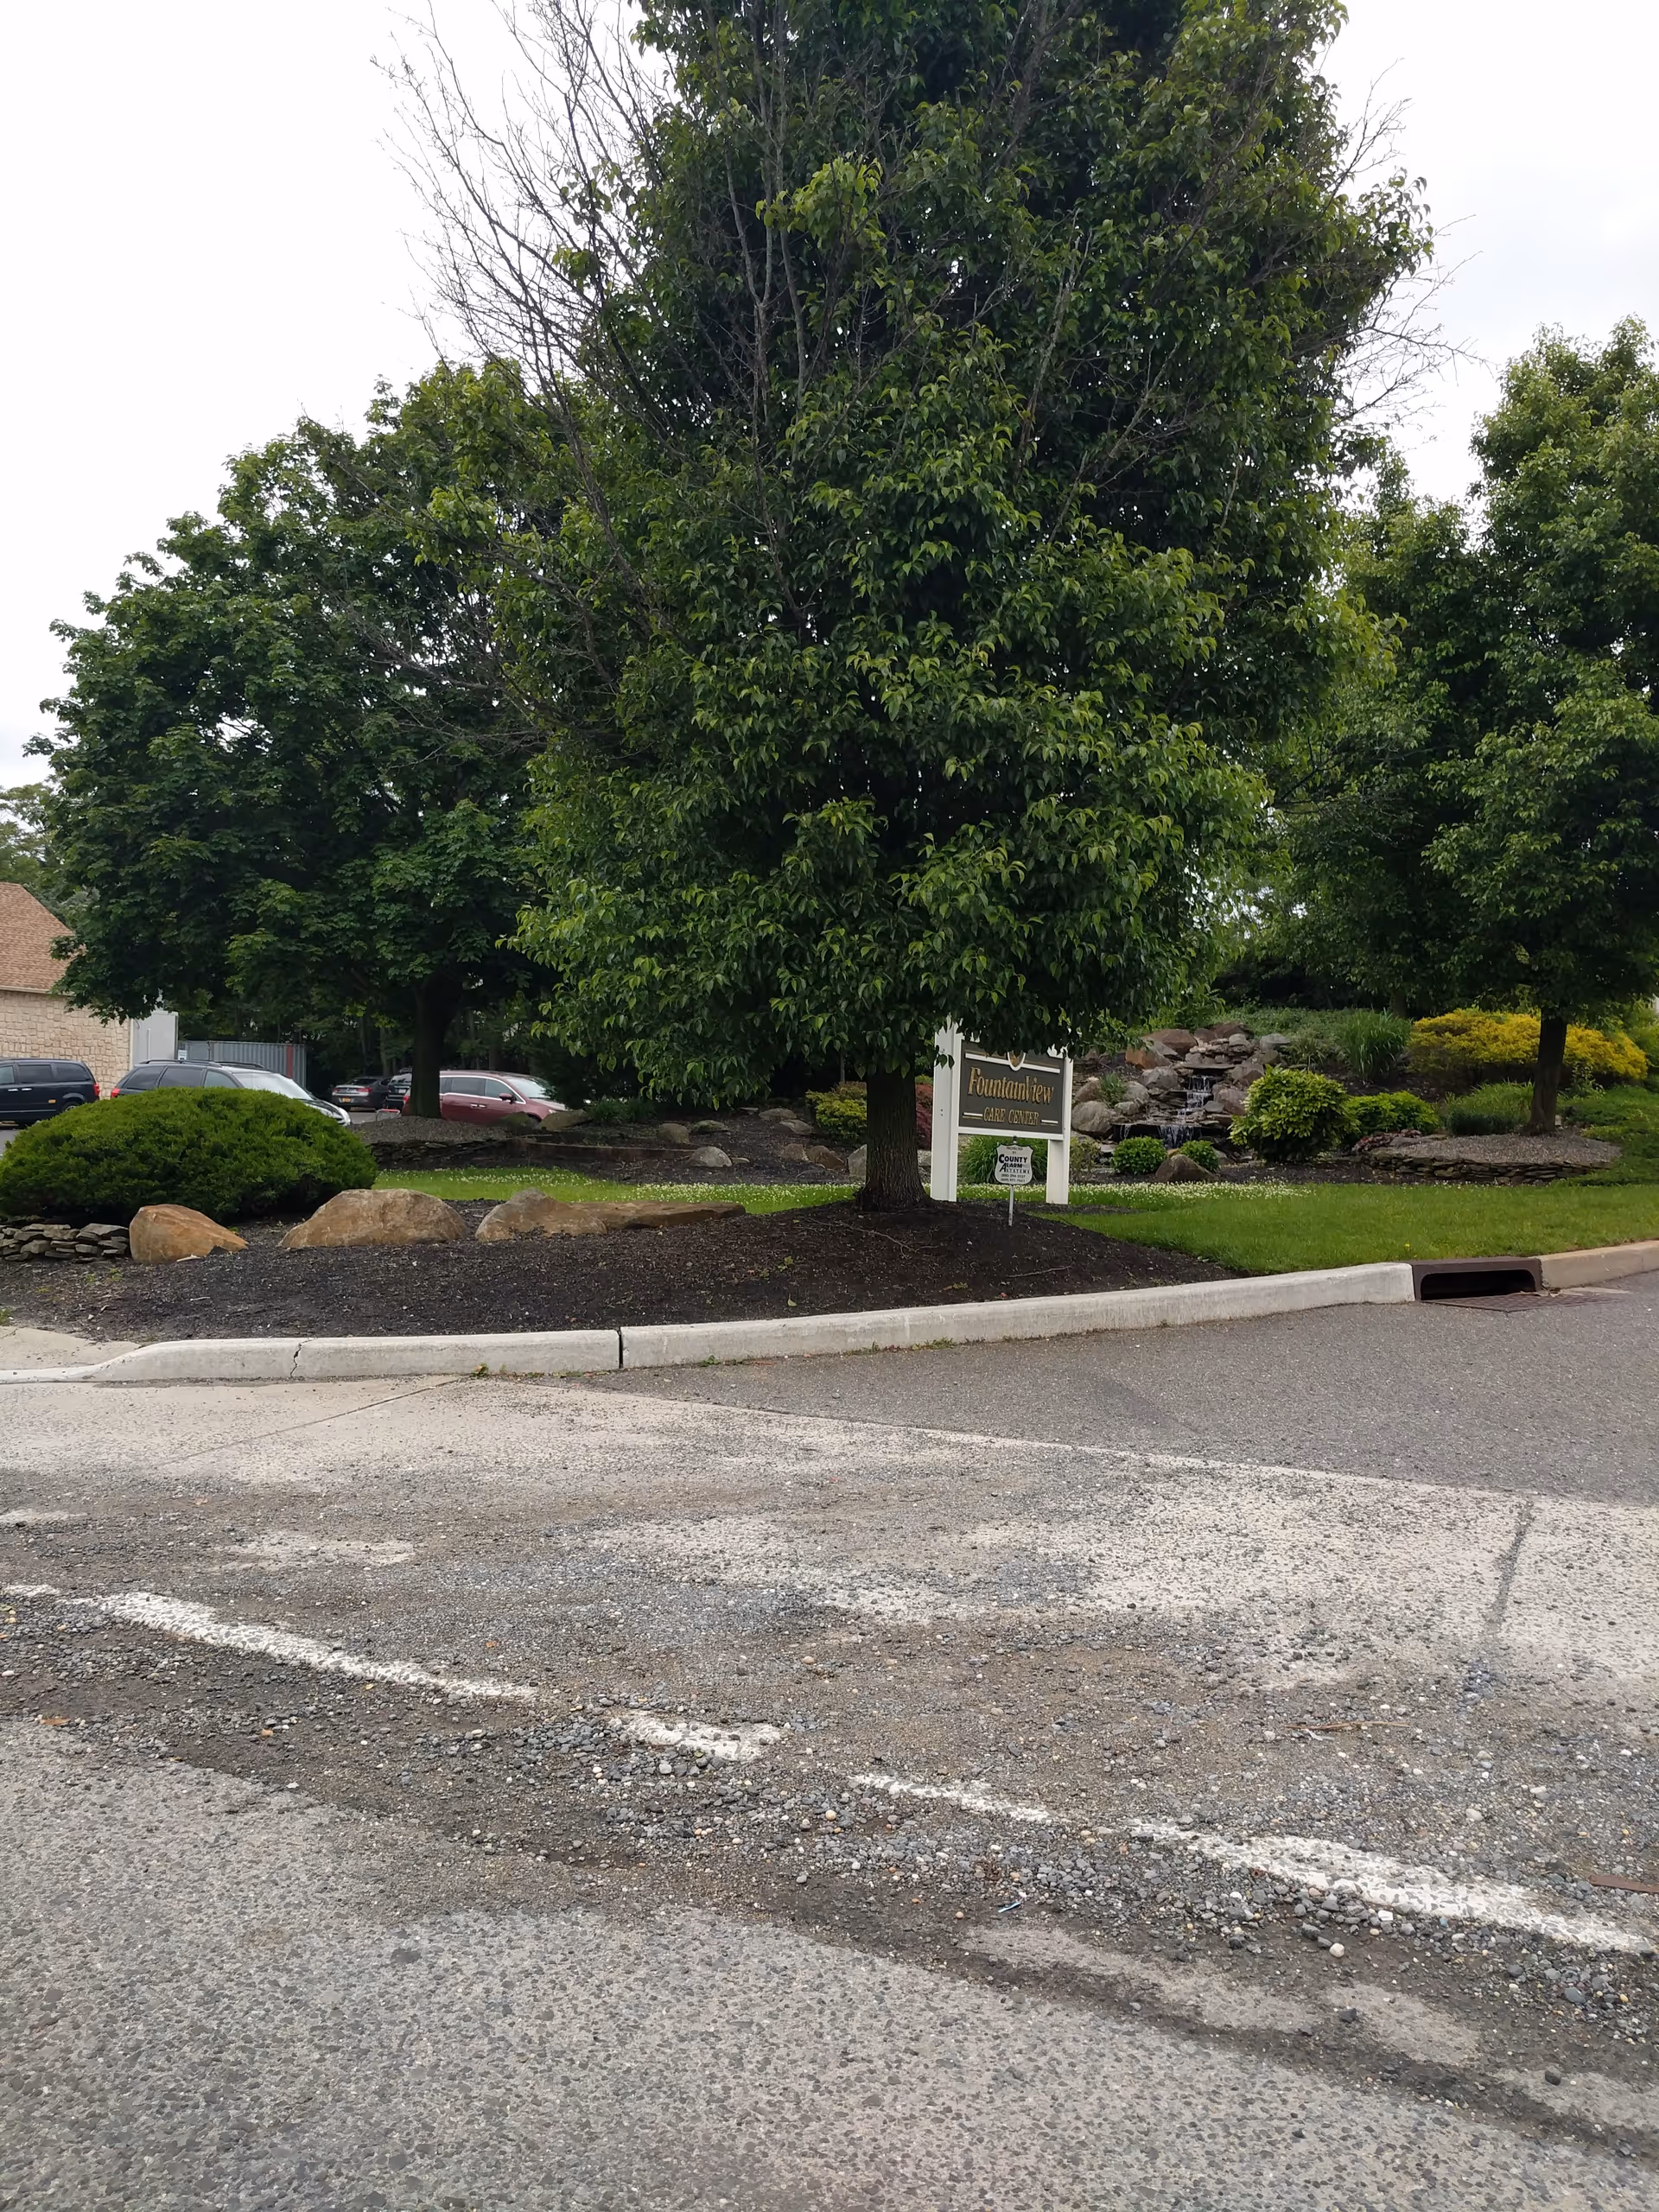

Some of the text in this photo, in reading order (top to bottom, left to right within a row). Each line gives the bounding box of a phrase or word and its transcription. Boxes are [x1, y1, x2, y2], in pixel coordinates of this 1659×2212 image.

[983, 1107, 1039, 1126] CARE CENTER
[998, 1154, 1028, 1164] COUNTY
[999, 1162, 1023, 1173] ALARM
